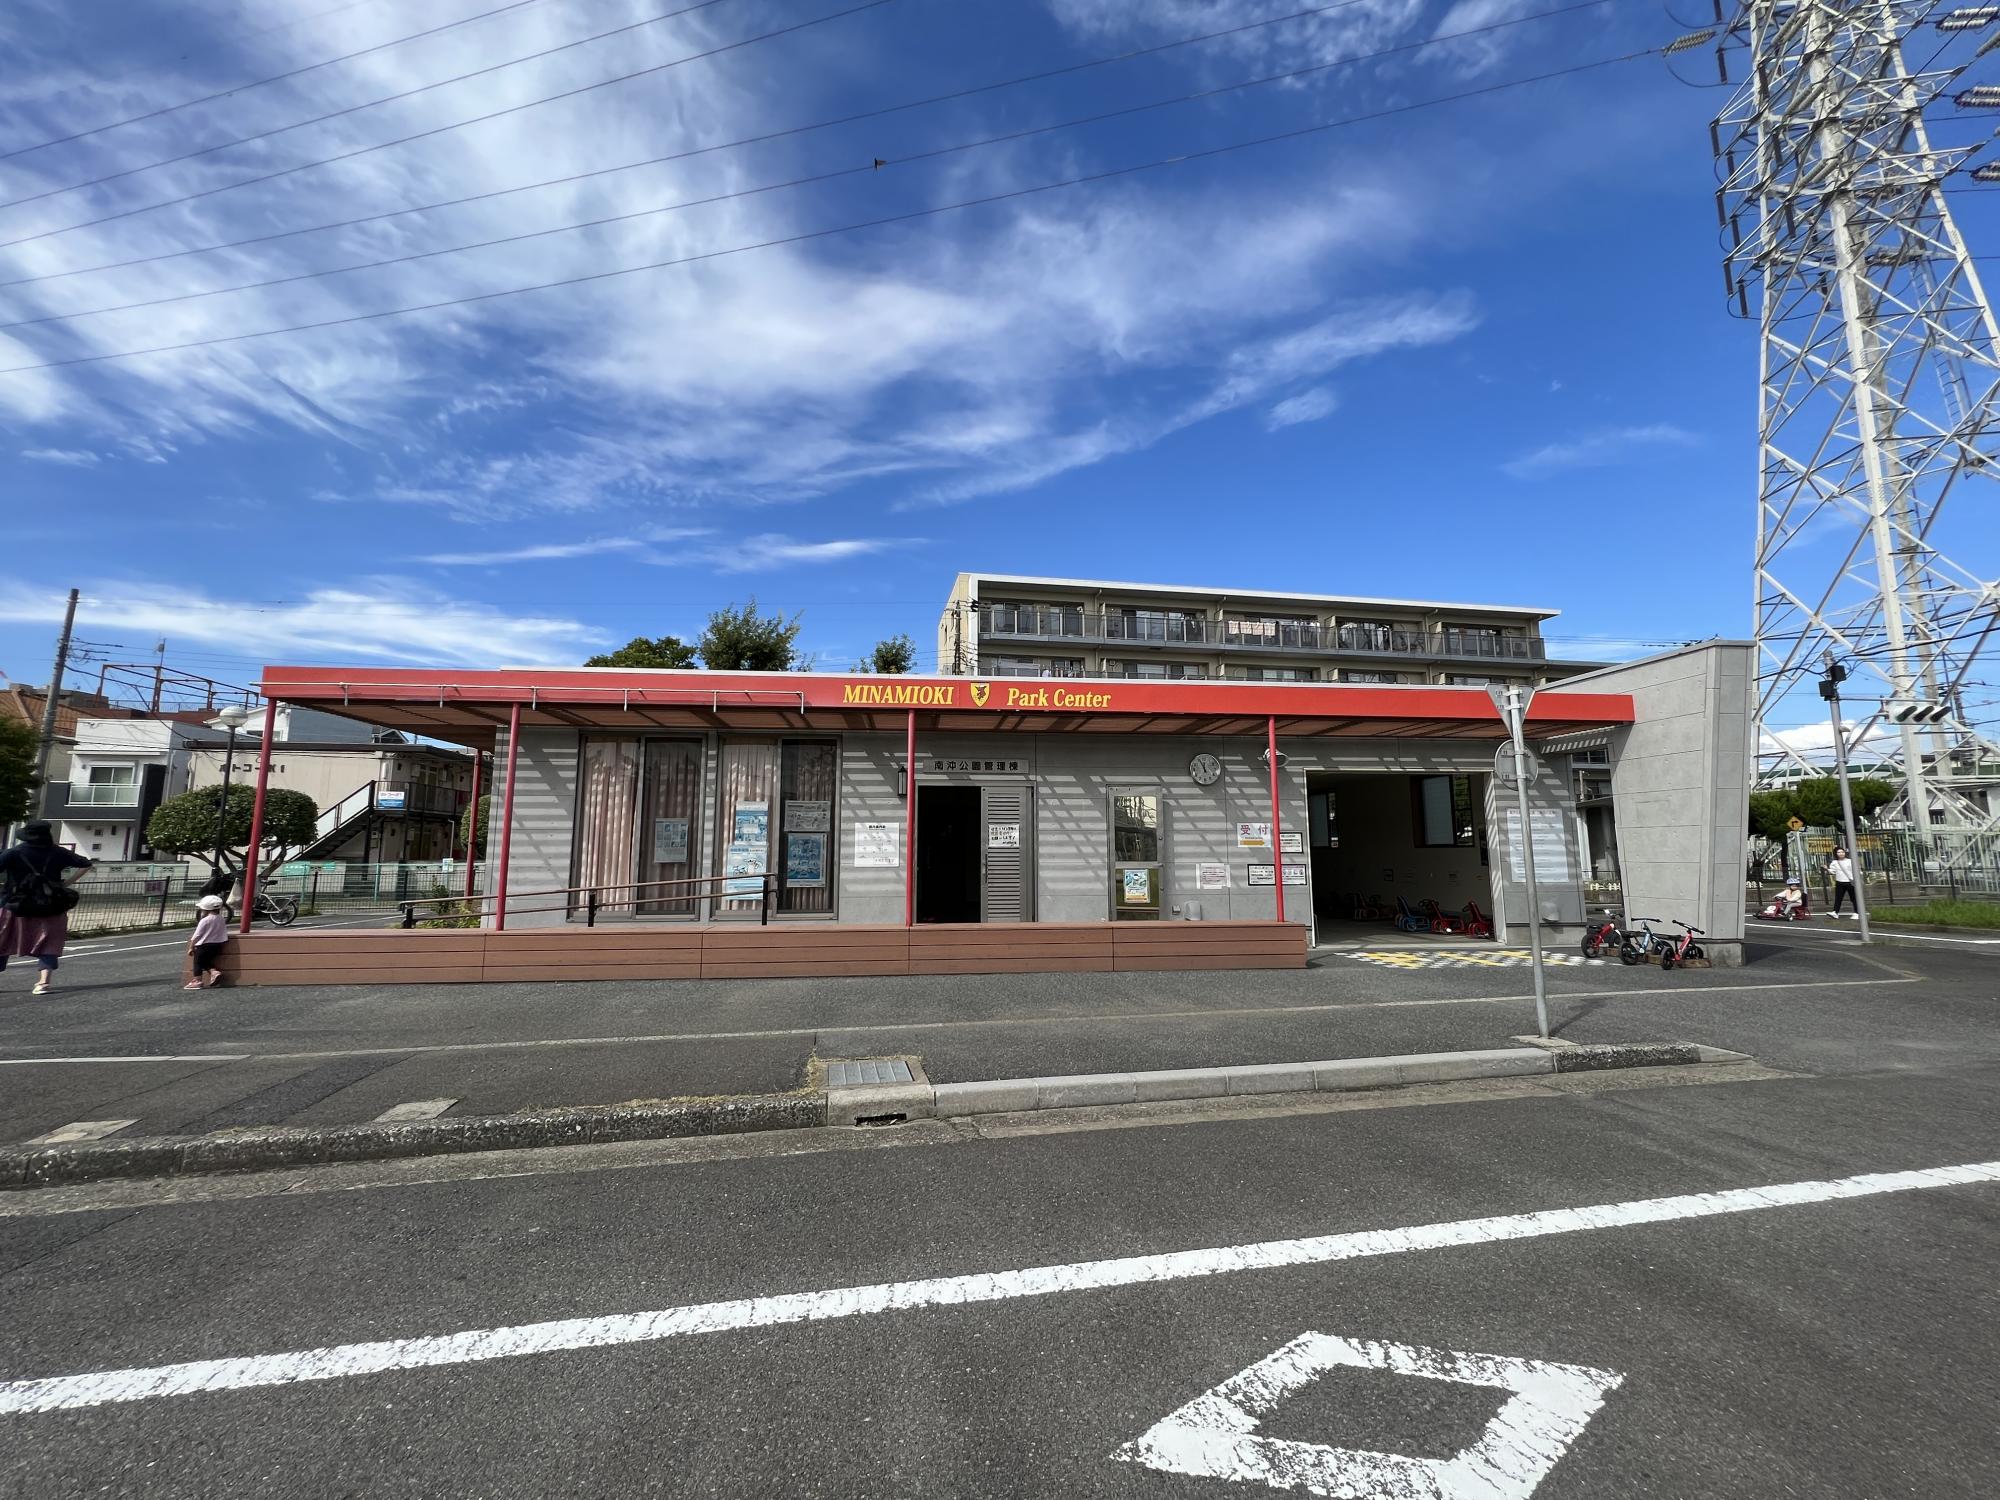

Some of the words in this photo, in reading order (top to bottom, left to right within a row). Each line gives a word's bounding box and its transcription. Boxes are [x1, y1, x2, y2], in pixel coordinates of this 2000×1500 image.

[843, 684, 954, 705] MINAMIOKI
[1007, 687, 1049, 707] Park
[1053, 688, 1112, 708] Center
[934, 760, 1018, 771] 南沖公園管理棟
[1240, 824, 1268, 836] 受付
